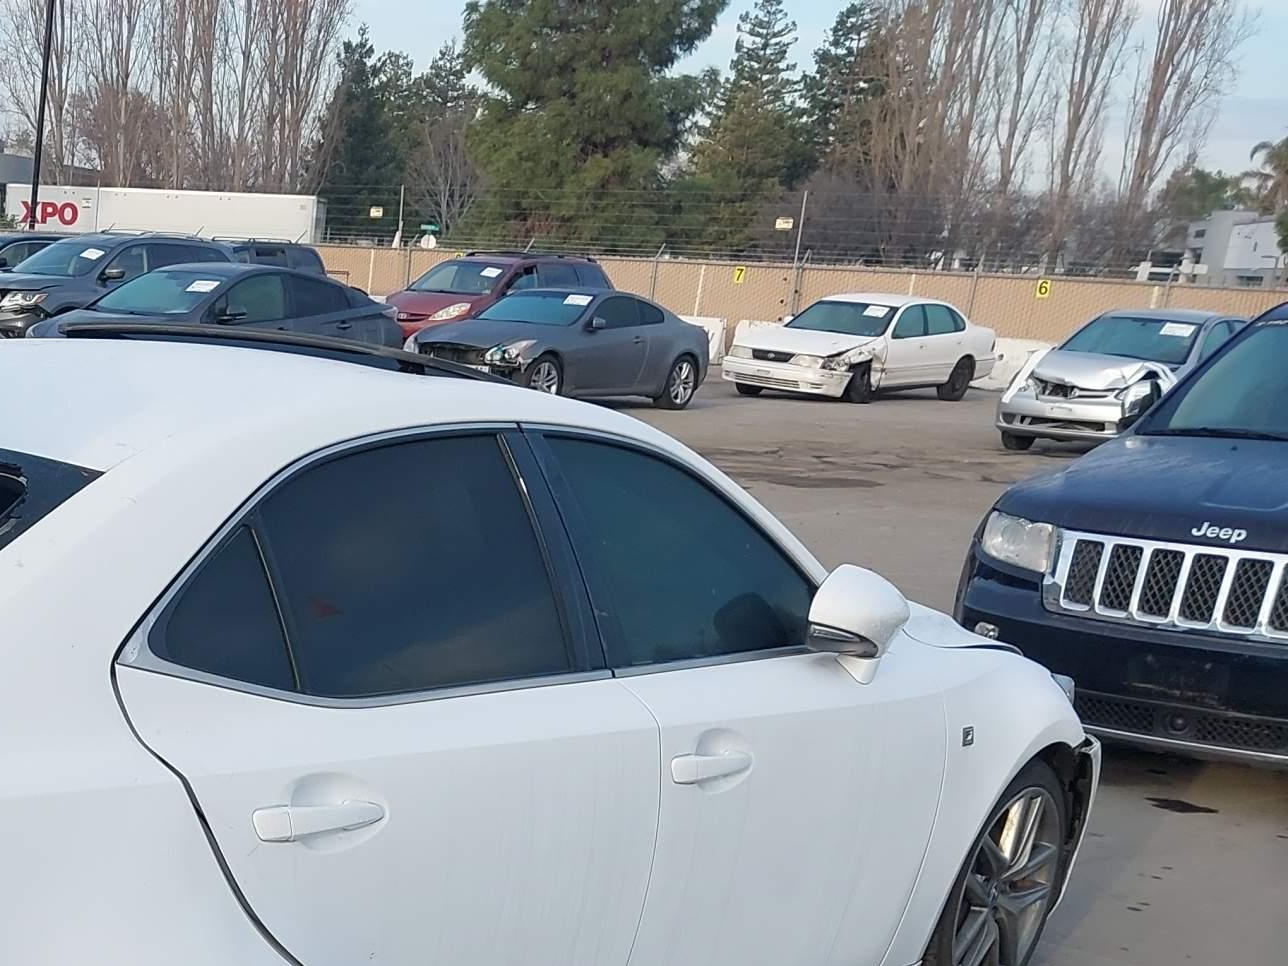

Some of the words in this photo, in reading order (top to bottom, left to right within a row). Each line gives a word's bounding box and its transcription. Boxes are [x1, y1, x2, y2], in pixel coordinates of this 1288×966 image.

[19, 201, 79, 226] XPO
[737, 268, 744, 281] 7
[1038, 280, 1048, 295] 6
[1191, 521, 1248, 544] Jeep
